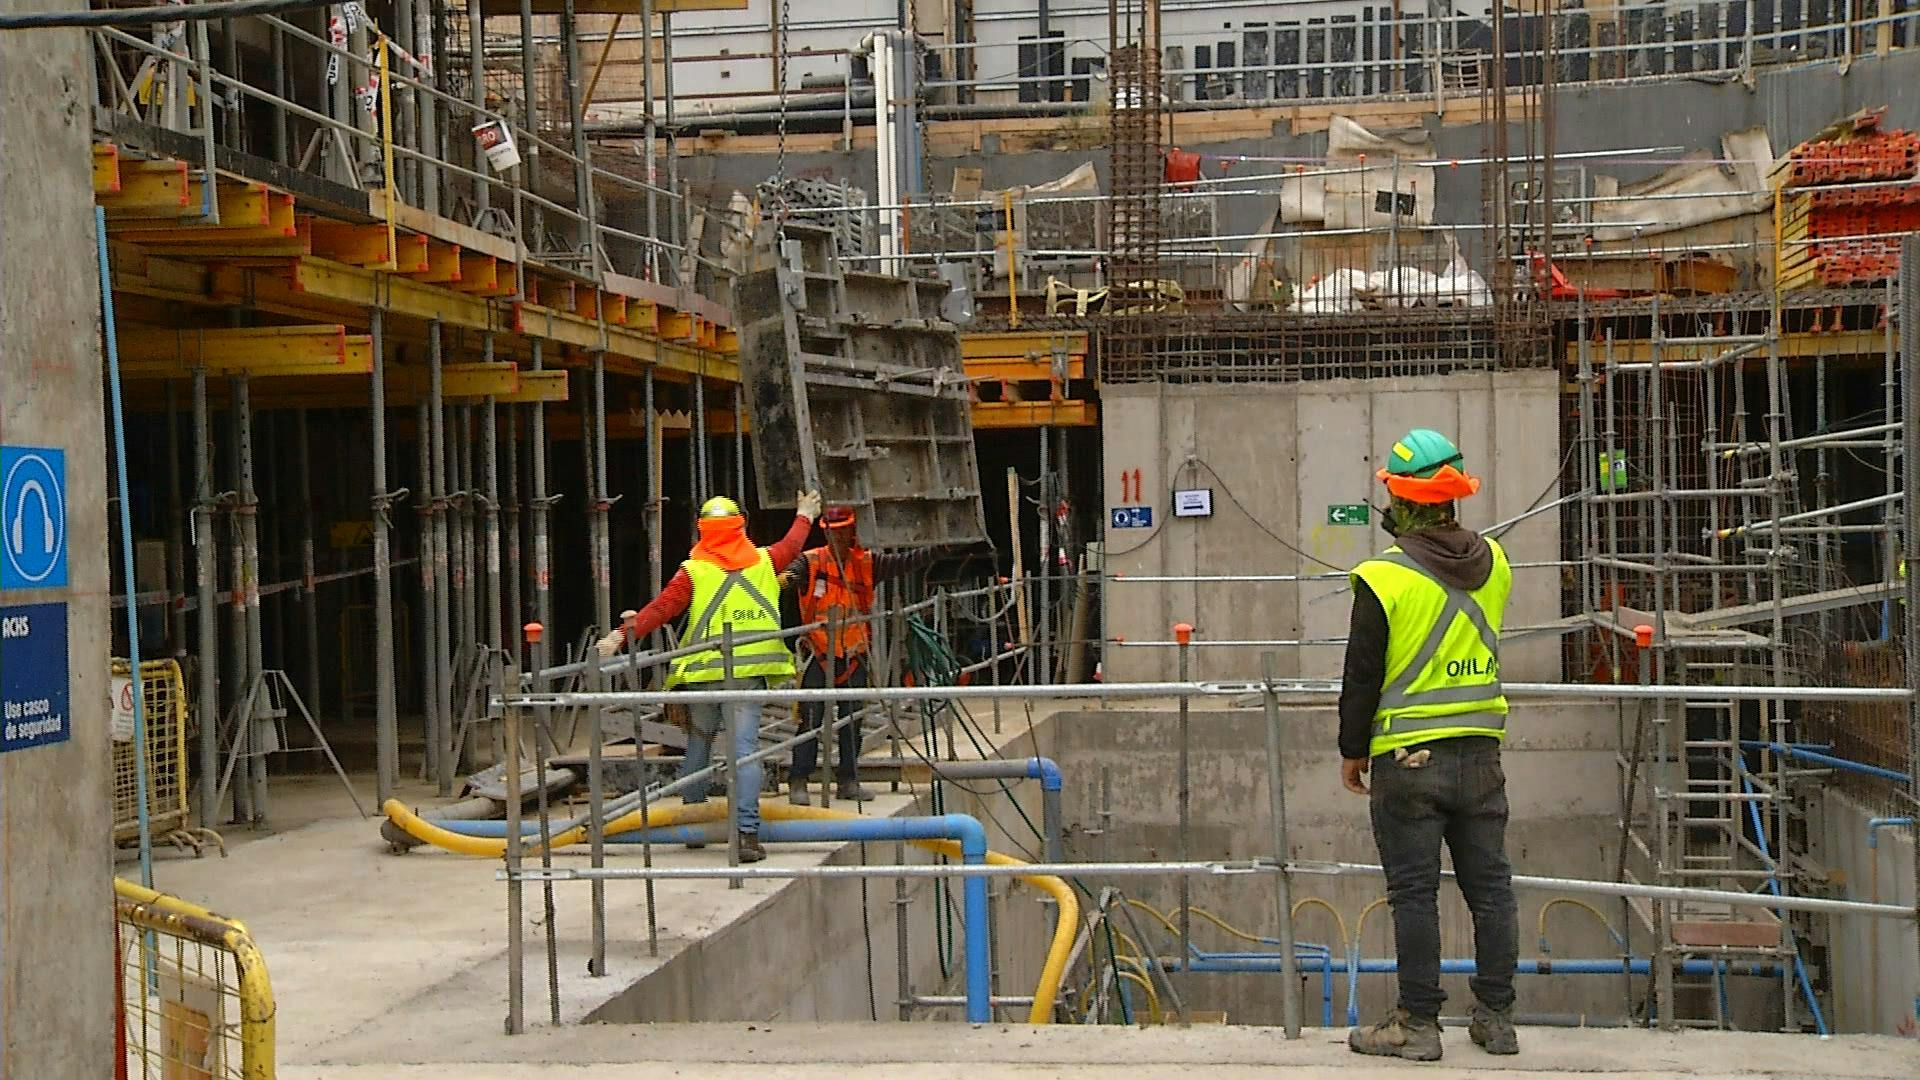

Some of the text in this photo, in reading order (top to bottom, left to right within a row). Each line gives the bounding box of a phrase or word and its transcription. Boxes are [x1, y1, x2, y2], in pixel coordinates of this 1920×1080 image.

[2, 616, 29, 638] ACHS
[1446, 656, 1495, 676] OHLA
[5, 699, 49, 718] Use casco
[5, 713, 61, 740] de seguridad
